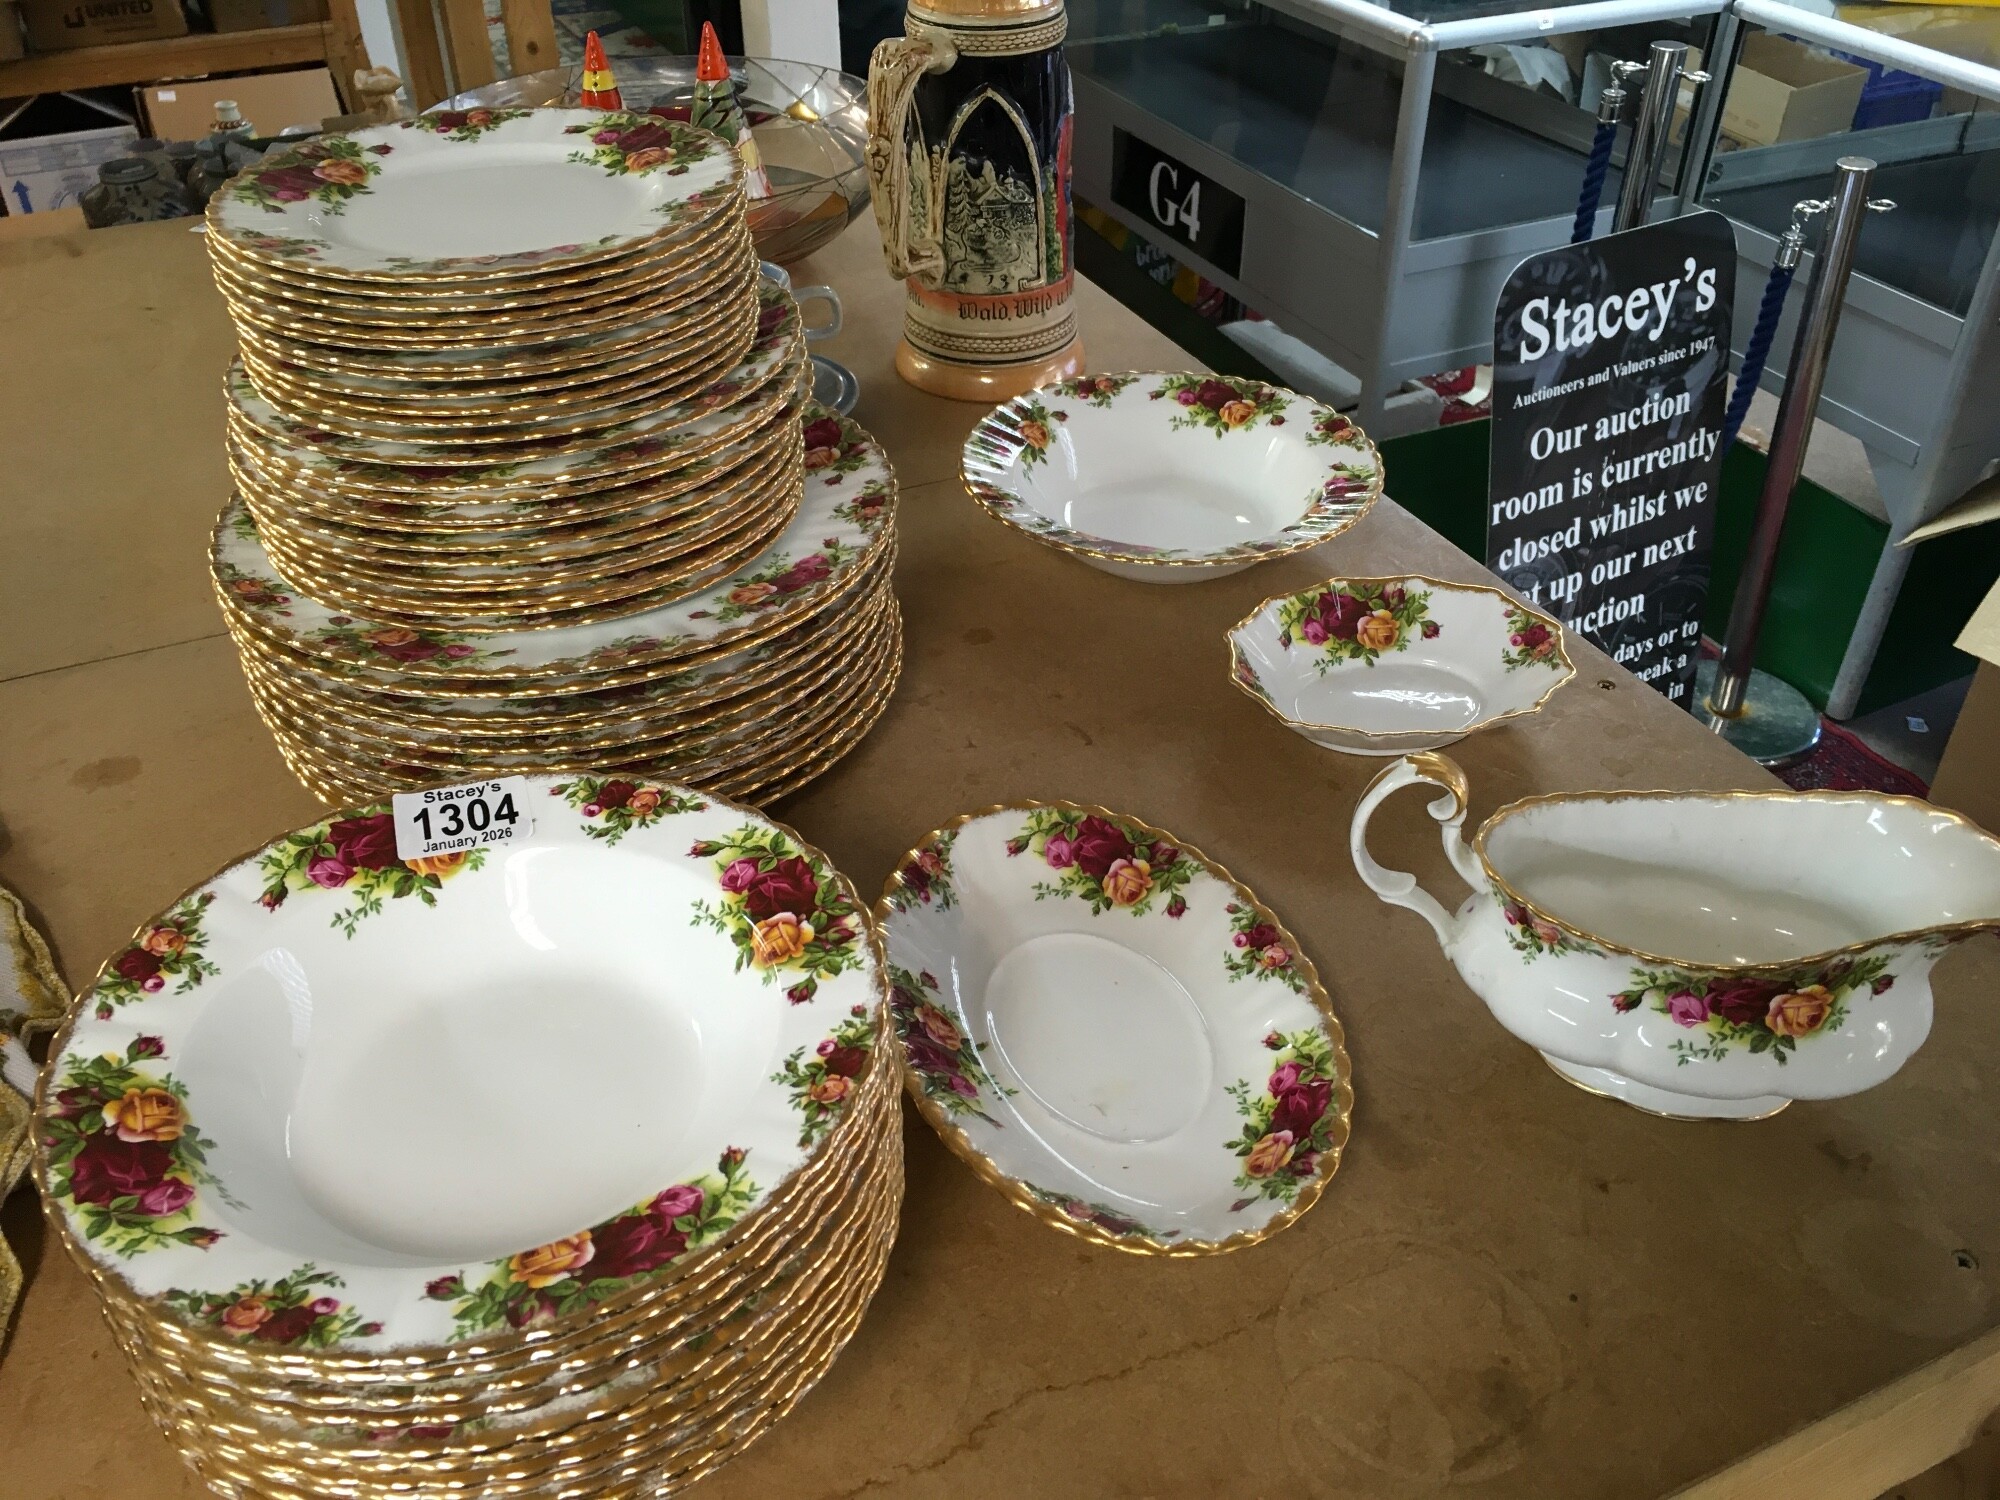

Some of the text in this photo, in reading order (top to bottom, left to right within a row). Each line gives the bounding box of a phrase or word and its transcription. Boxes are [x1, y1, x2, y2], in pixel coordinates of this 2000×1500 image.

[1149, 161, 1200, 243] G4
[1512, 335, 1716, 410] Auctioneers and Valuers since 1947
[1530, 390, 1691, 461] Our auction
[1491, 427, 1722, 526] room is currently
[1499, 480, 1709, 572] closed whilst we
[1550, 571, 1583, 604] up
[1591, 553, 1638, 587] our
[1643, 525, 1698, 568] next
[1568, 593, 1645, 635] uction
[1613, 620, 1699, 663] days or to
[1677, 653, 1687, 669] a
[413, 792, 520, 841] 1304
[423, 782, 502, 804] Stacey's
[422, 827, 513, 853] January 2026
